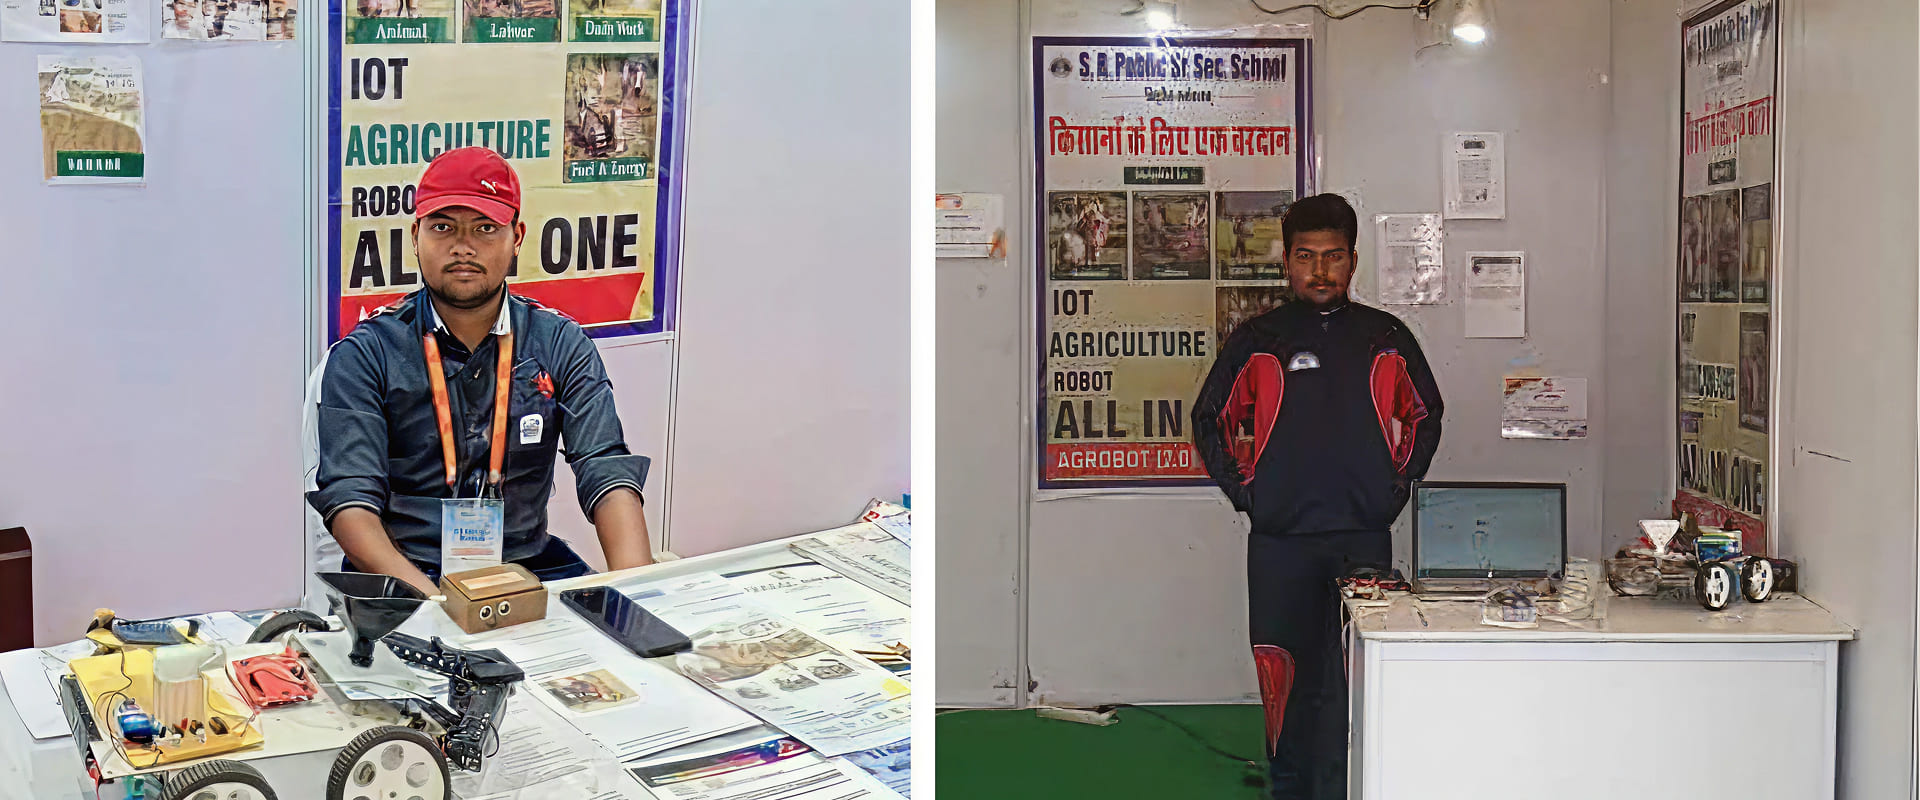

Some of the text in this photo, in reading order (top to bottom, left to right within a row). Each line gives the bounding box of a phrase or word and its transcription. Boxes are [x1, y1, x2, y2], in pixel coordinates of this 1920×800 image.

[351, 57, 409, 100] IOT
[1231, 126, 1291, 156] वरदान
[351, 185, 418, 218] ROBO
[349, 228, 418, 289] AL
[540, 213, 639, 275] ONE
[1053, 289, 1094, 316] IOT
[1050, 330, 1206, 358] AGRICULTURE
[1054, 371, 1113, 392] ROBOT
[1054, 399, 1183, 439] ALL IN
[1058, 449, 1150, 469] AGROBOT
